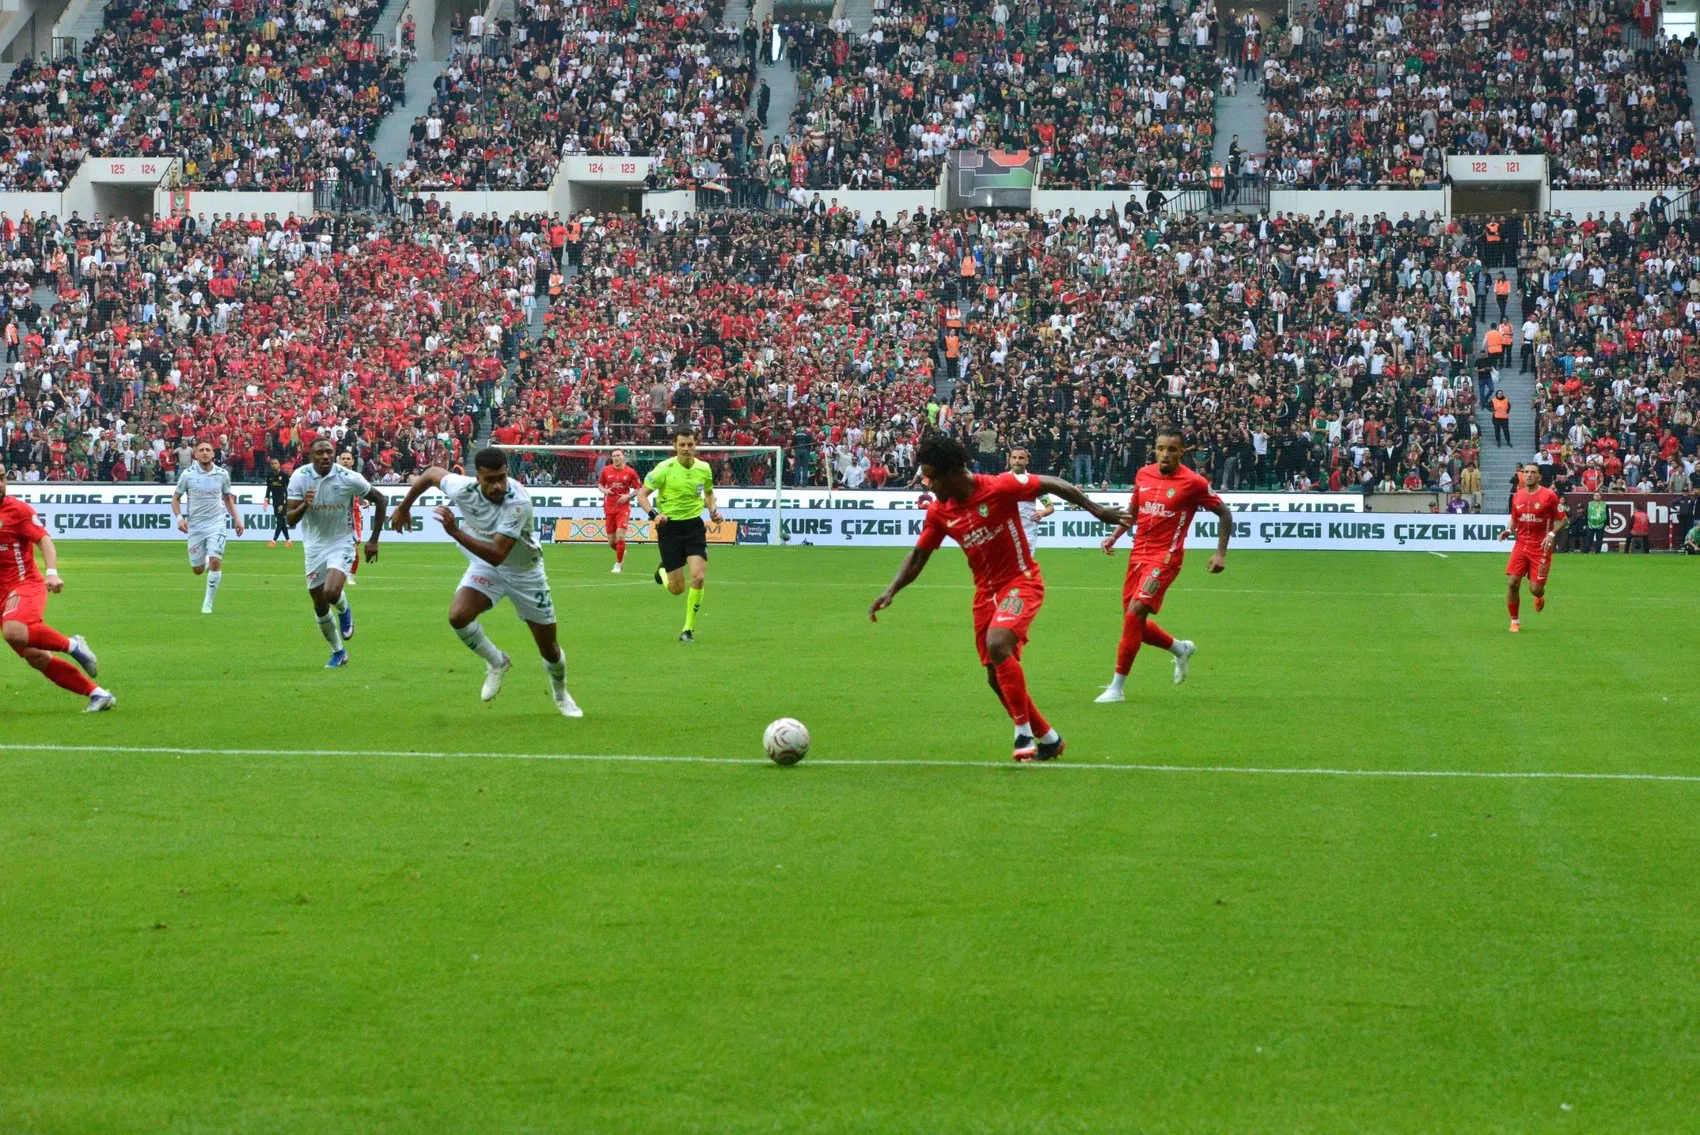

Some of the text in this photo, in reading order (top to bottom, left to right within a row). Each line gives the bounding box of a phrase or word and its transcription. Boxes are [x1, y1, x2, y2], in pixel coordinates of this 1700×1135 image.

[111, 164, 157, 175] 125 124
[588, 163, 636, 174] 124 123
[1472, 161, 1520, 173] 122 121
[118, 513, 171, 529] KURS
[781, 518, 832, 534] KURS
[1328, 522, 1385, 539] KURS
